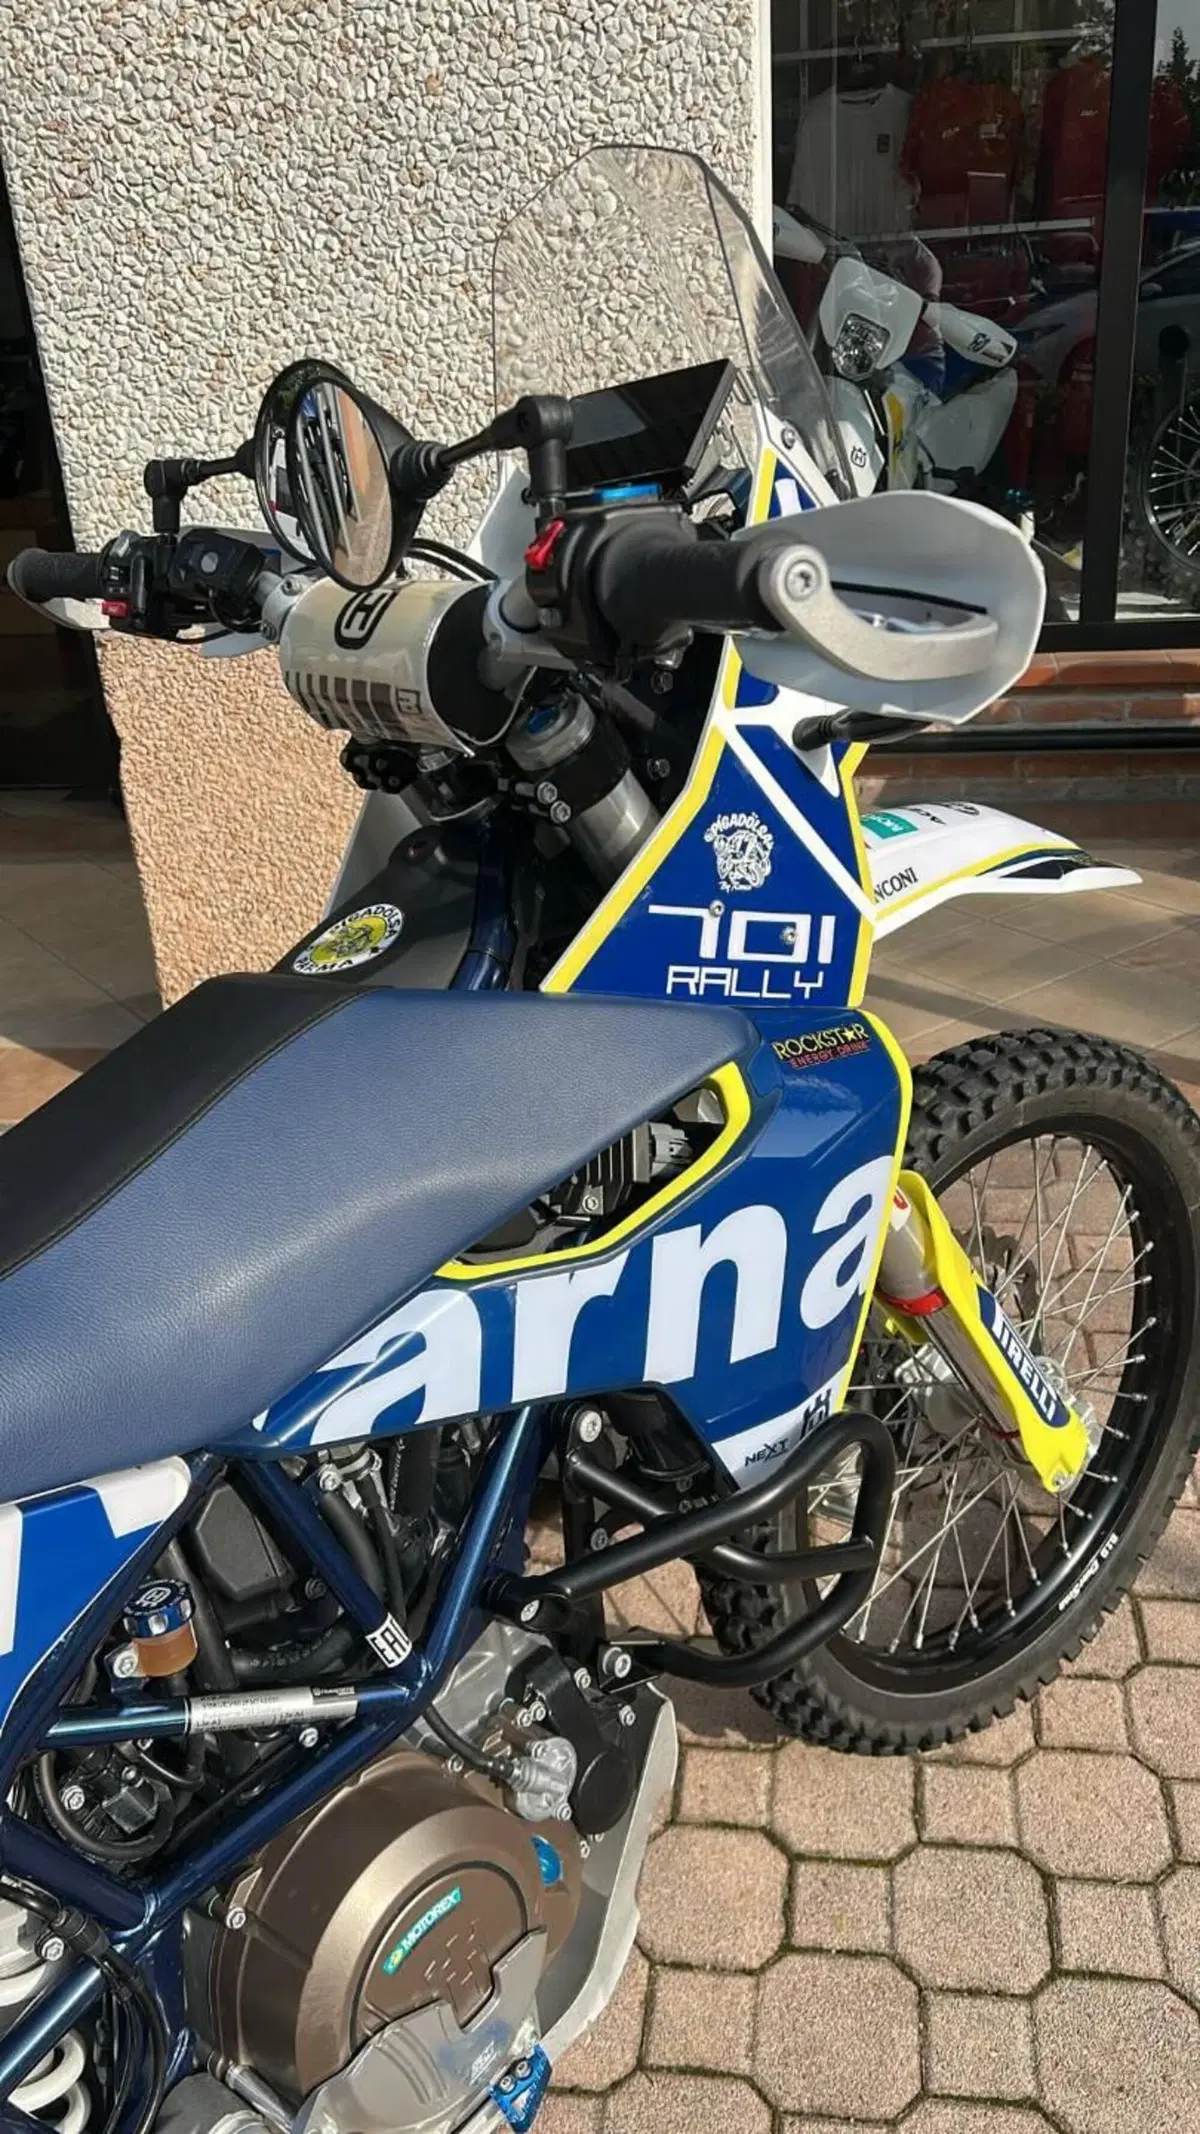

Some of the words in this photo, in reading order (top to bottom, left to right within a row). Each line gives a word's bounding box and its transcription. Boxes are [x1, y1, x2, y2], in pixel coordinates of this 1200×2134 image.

[648, 904, 836, 964] 701
[665, 964, 825, 1000] RALLY
[401, 1891, 460, 1951] MOTOREX
